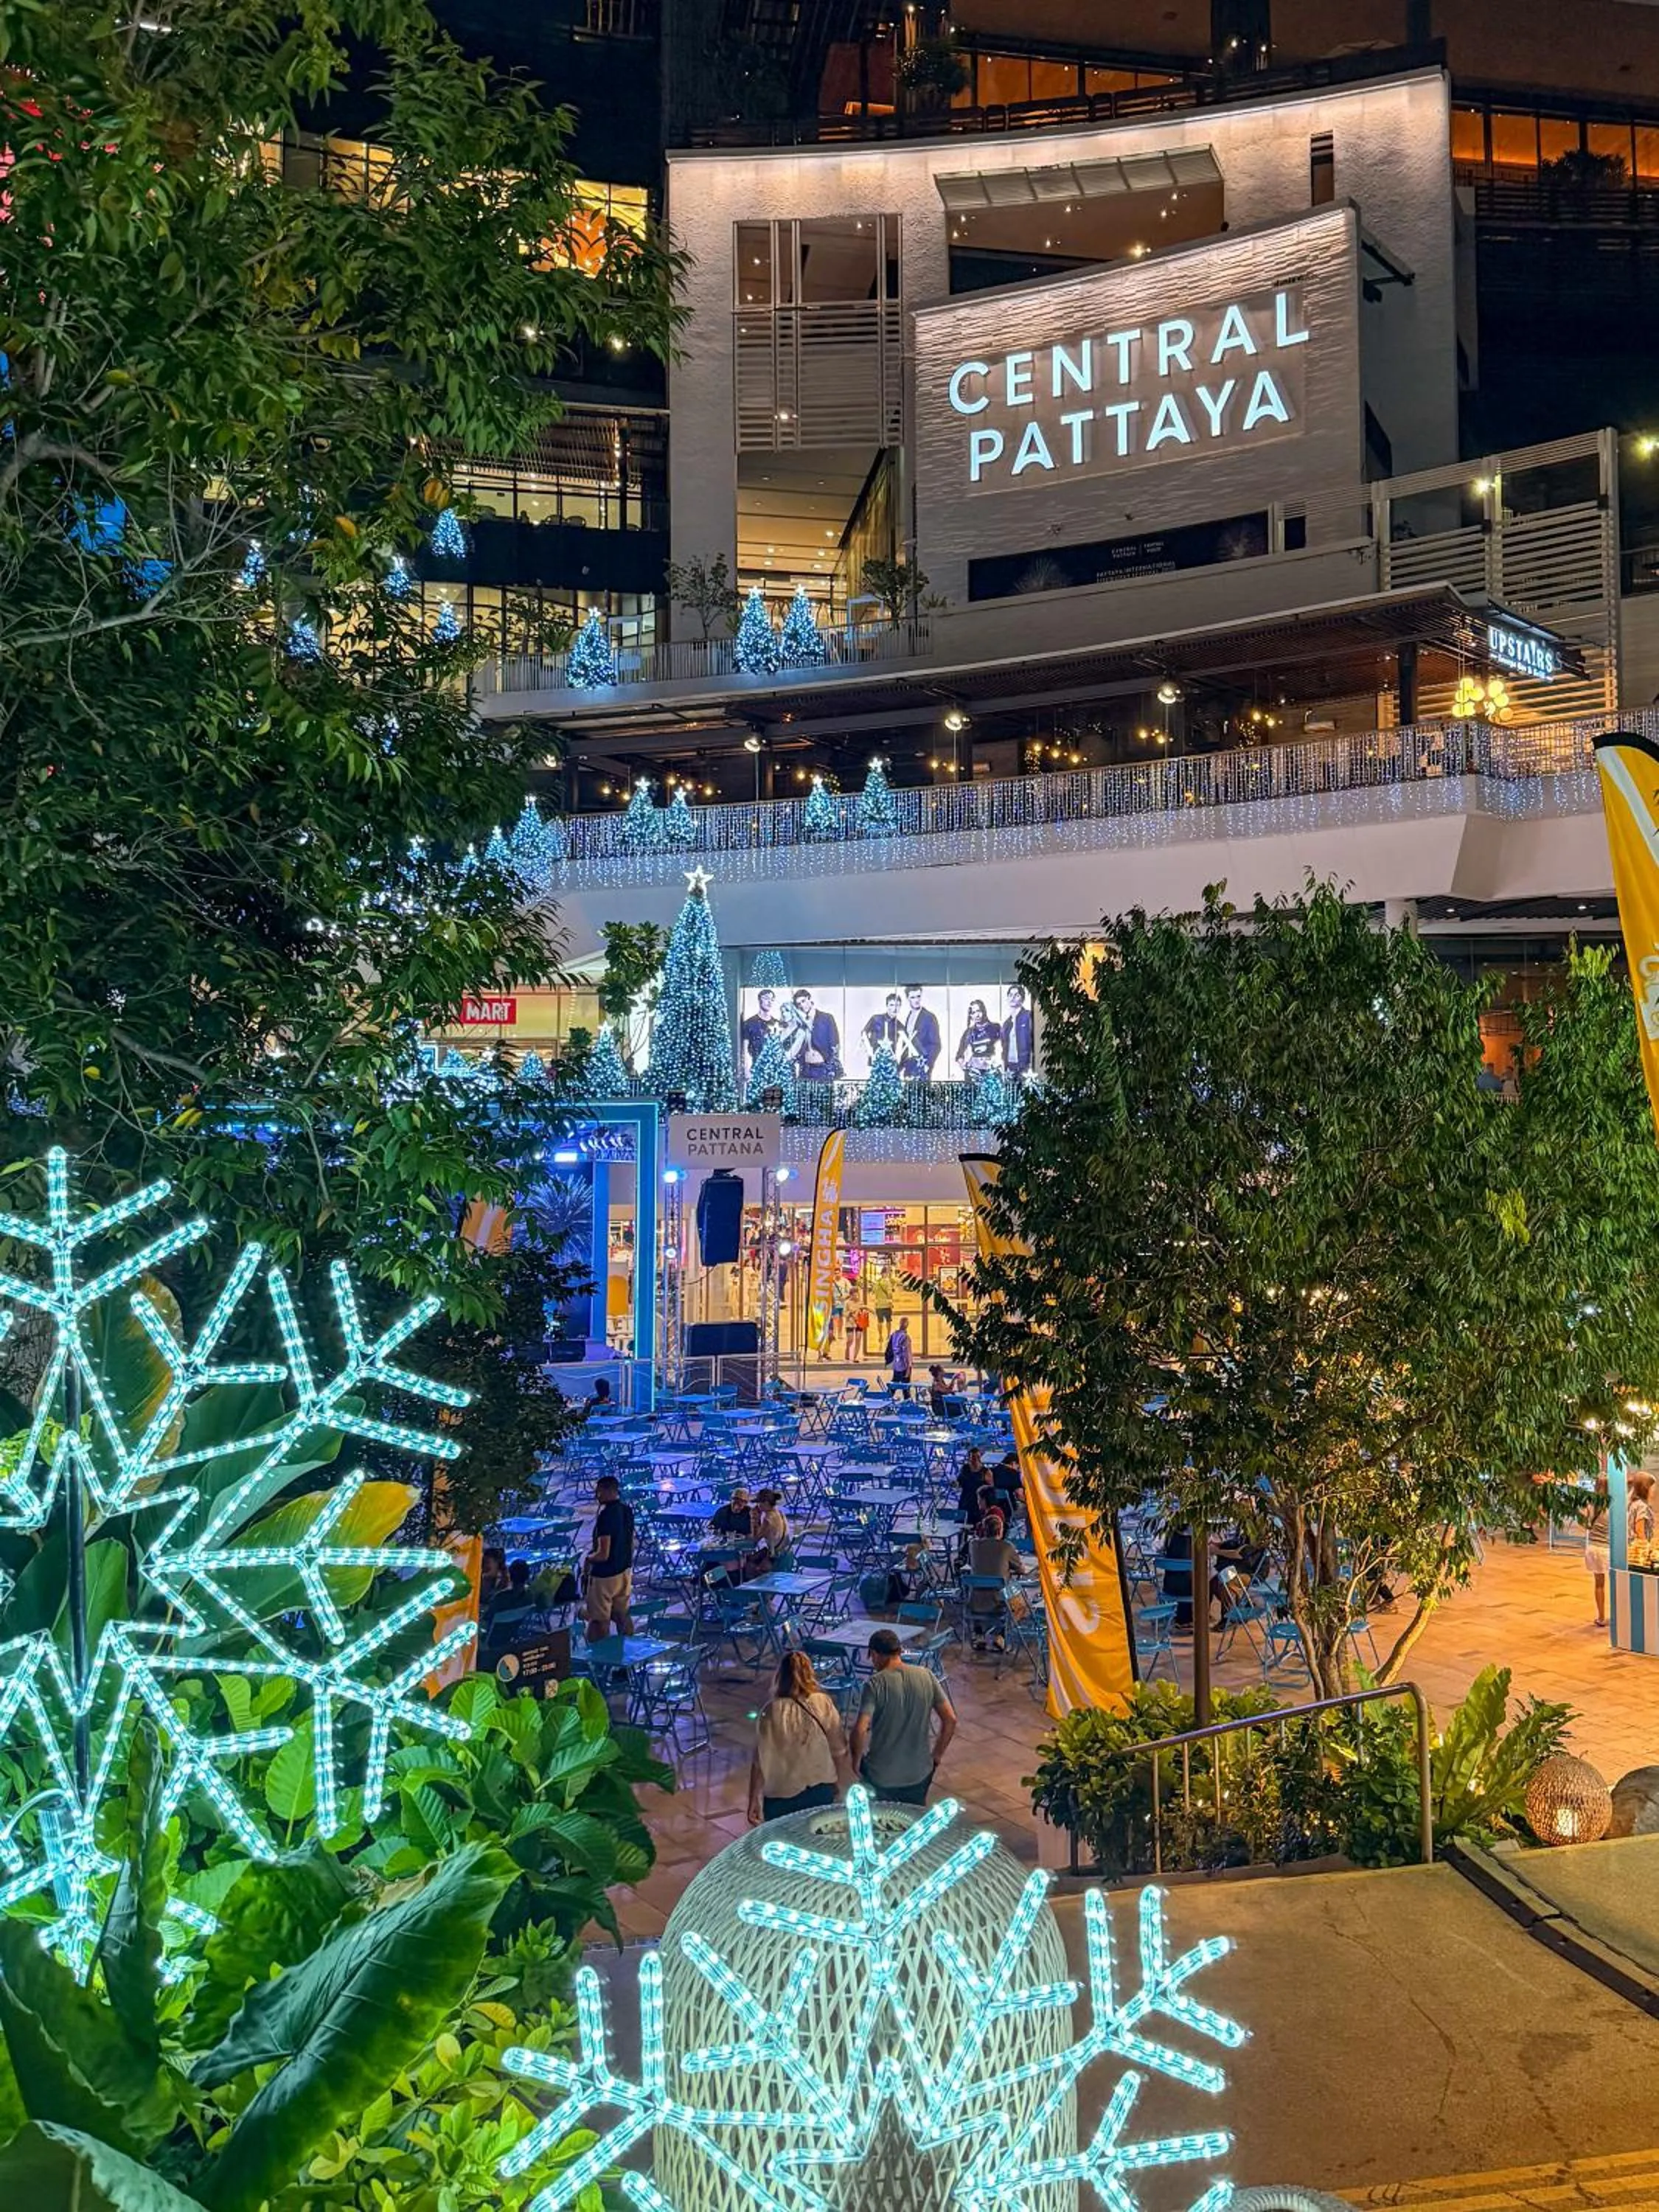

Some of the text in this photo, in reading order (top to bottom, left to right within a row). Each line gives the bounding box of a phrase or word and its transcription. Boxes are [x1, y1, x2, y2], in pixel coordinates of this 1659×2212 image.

[948, 291, 1310, 414] CENTRAL
[969, 369, 1290, 482] PATTAYA
[1489, 628, 1553, 673] UPSTAIRS
[465, 1001, 511, 1021] MART
[686, 1127, 765, 1141] CENTRAL
[687, 1142, 764, 1156] PATTANA
[815, 1209, 833, 1311] SINGHA
